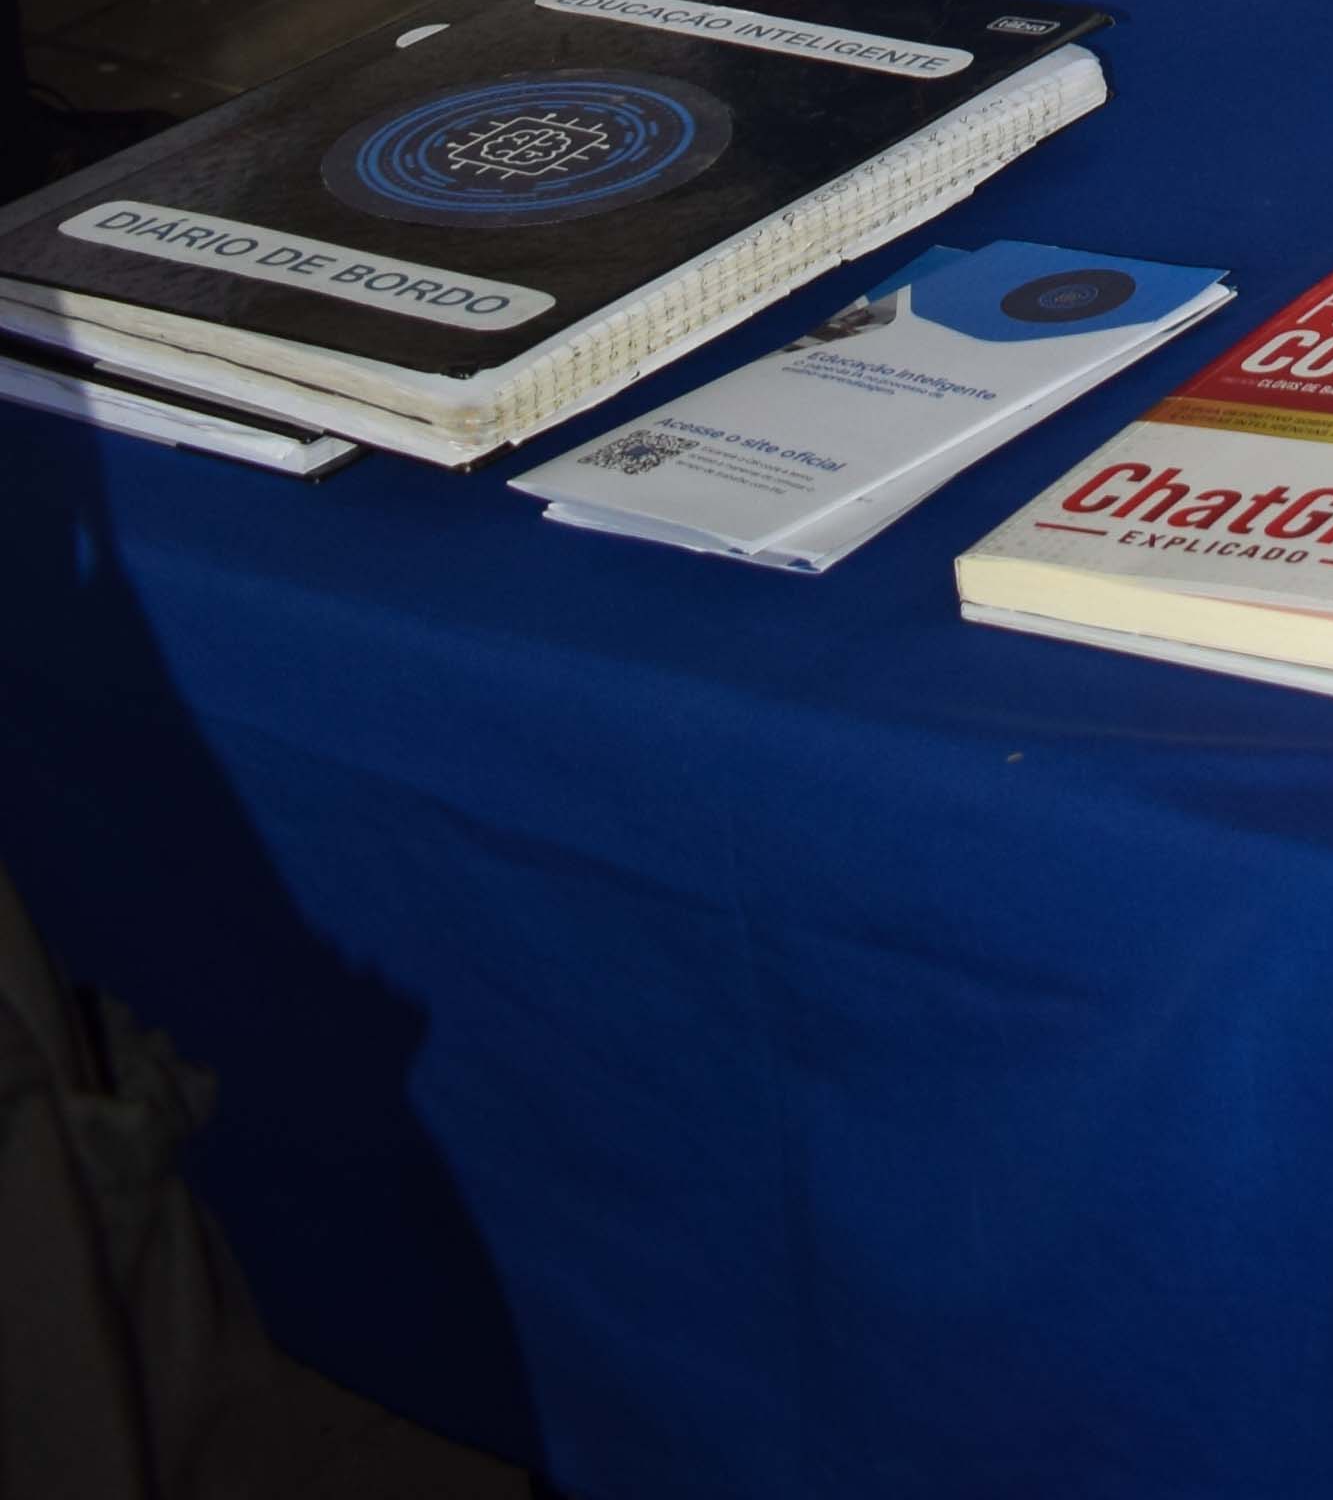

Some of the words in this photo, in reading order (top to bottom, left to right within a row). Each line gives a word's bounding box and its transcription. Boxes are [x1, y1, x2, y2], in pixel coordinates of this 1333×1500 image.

[734, 22, 952, 71] INTELIGENTE
[95, 210, 259, 257] DIÁRIO
[255, 246, 337, 275] DE
[330, 264, 512, 315] BORDO
[1118, 530, 1309, 564] EXPLICADO
